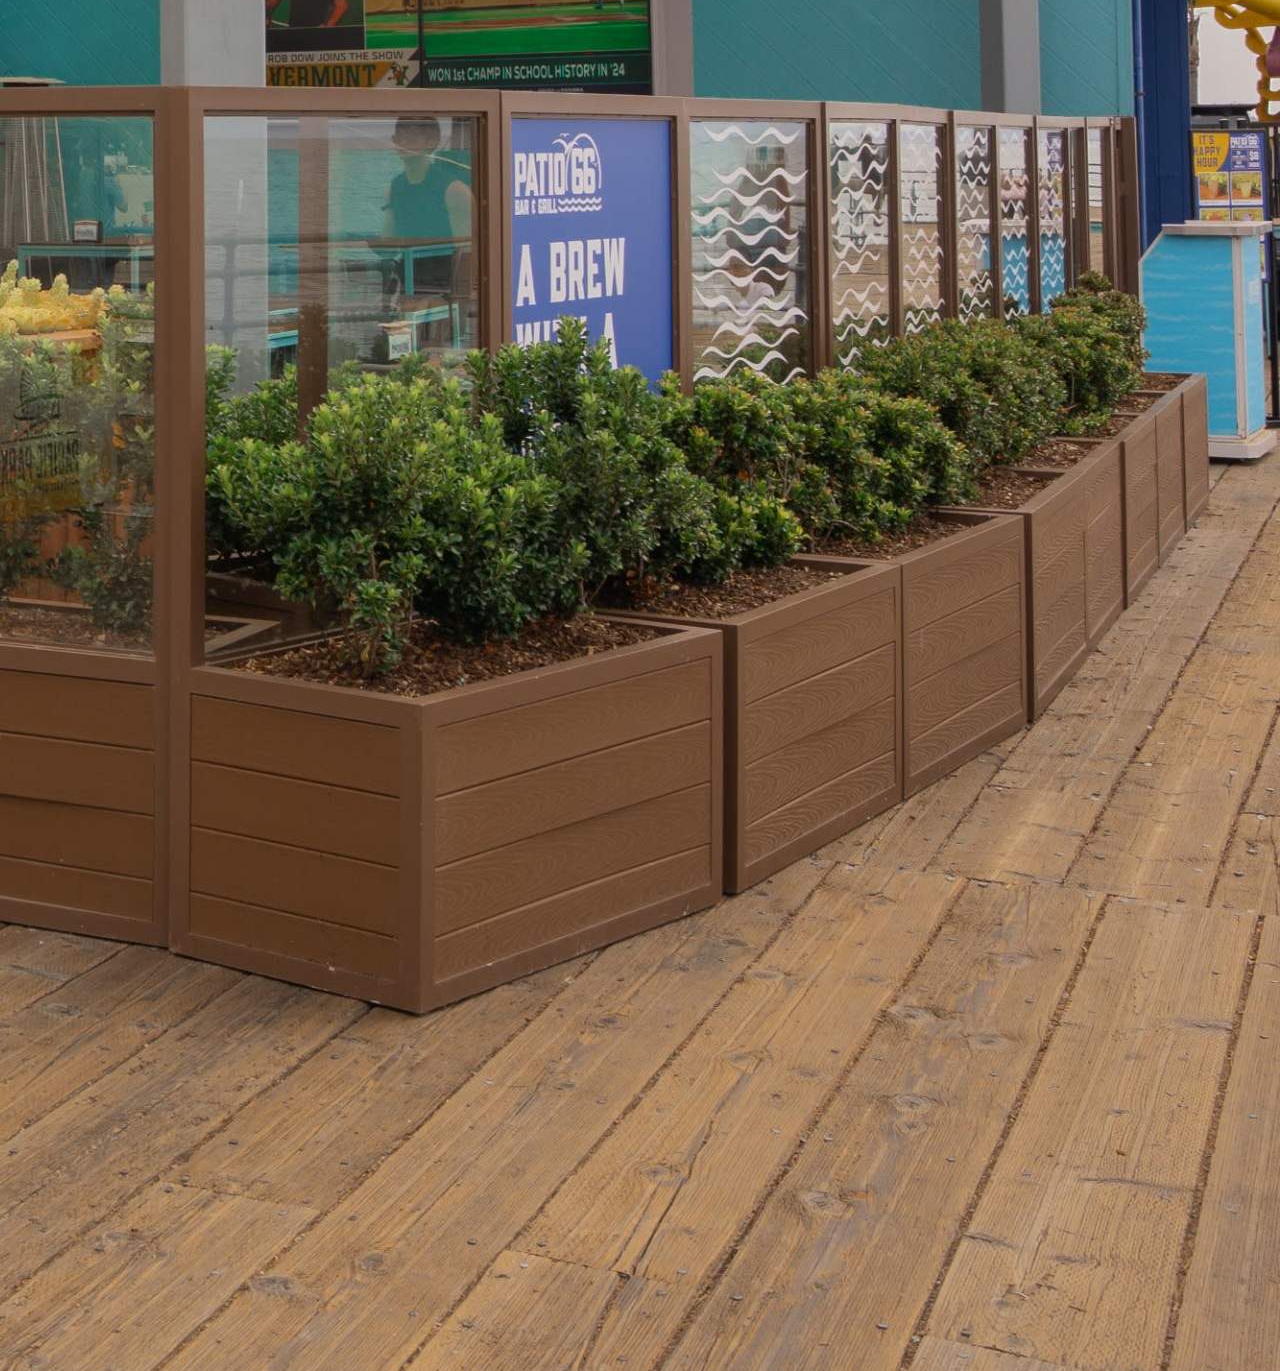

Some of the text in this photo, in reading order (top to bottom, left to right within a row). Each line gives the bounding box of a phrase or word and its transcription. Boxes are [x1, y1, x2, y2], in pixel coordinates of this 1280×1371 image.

[268, 51, 403, 63] ROB DOW JOINS THE SHOW
[268, 64, 377, 86] VERMONT
[428, 68, 451, 81] WON
[453, 68, 465, 81] 1st
[467, 66, 501, 80] CHAMP
[502, 66, 512, 79] IN
[514, 64, 554, 79] SCHOOL
[555, 63, 597, 78] HISTORY
[598, 63, 608, 77] IN
[514, 148, 596, 197] PATIO 66
[515, 198, 529, 216] BAR
[538, 197, 559, 214] GRILL
[516, 237, 625, 307] A BREW
